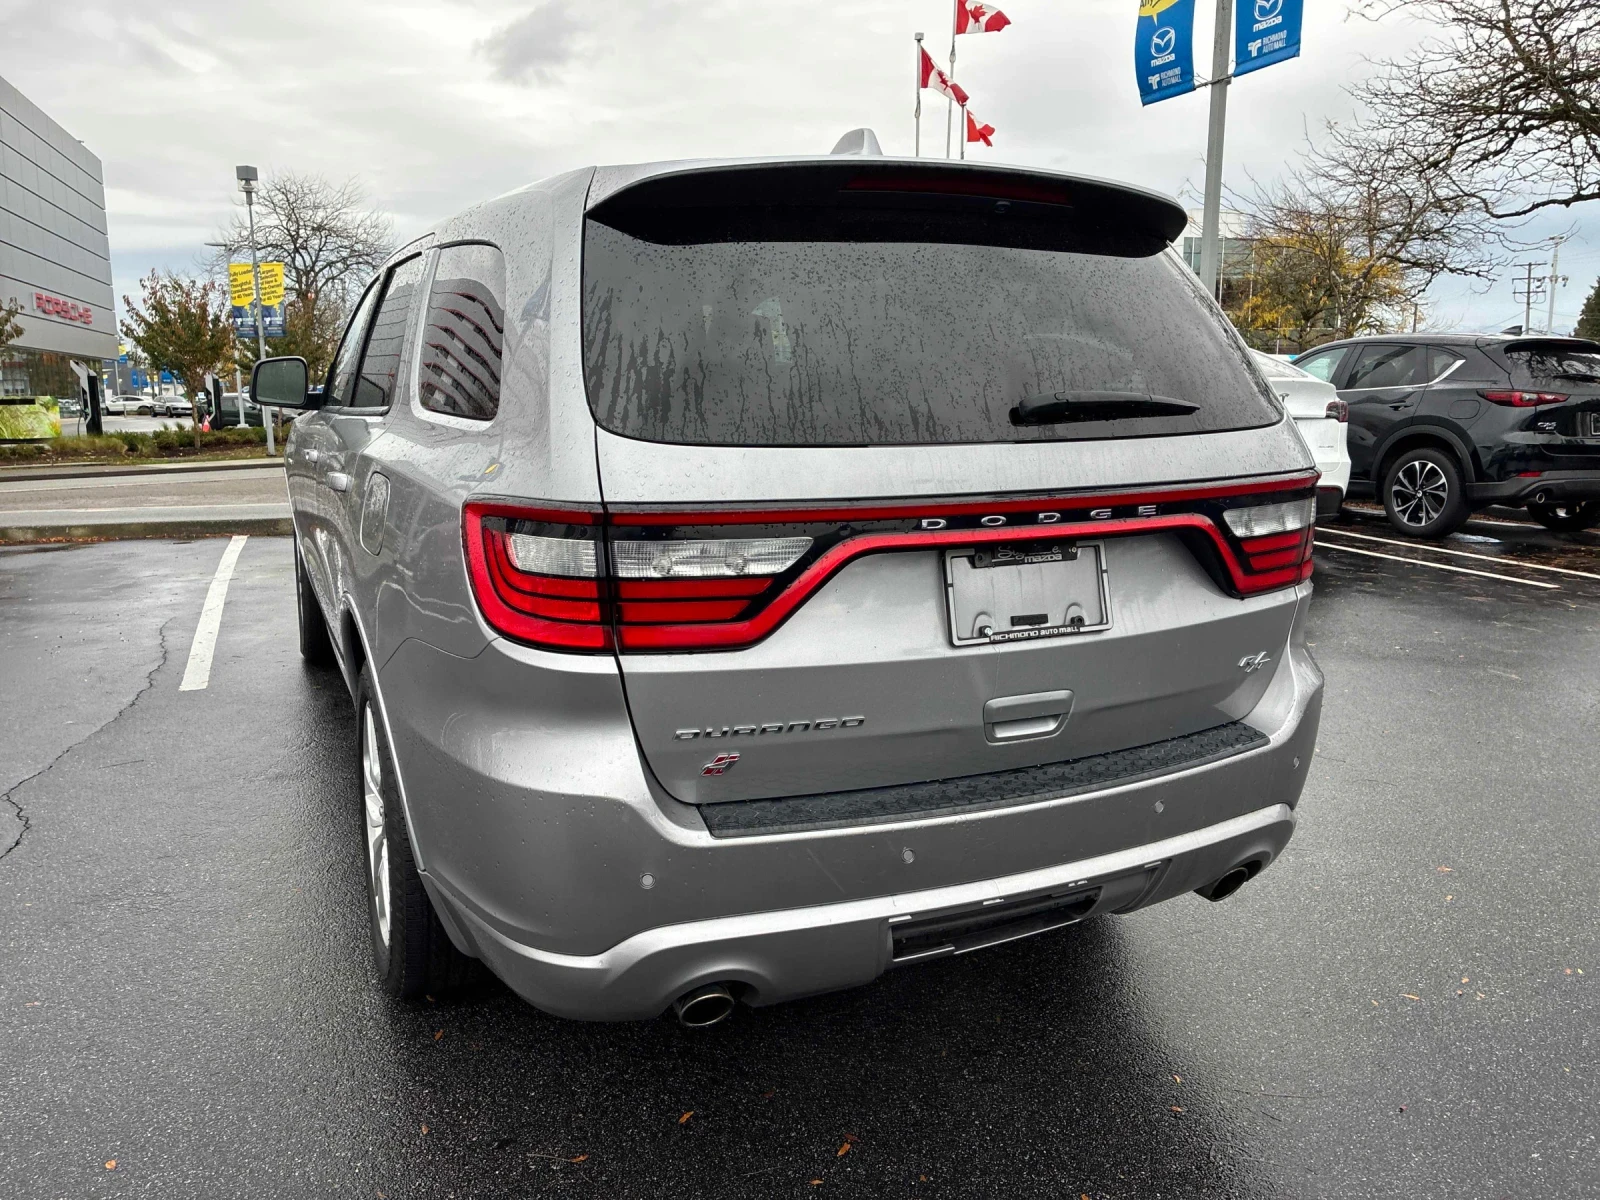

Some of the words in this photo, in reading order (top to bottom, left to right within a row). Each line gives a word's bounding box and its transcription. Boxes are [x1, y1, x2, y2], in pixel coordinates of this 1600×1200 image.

[1253, 15, 1283, 32] mazda
[1263, 30, 1288, 45] RICHMOND
[1151, 53, 1176, 67] mazda
[1160, 66, 1182, 79] RICHMOND
[31, 292, 93, 325] PORSCHE
[921, 504, 1158, 530] DODGE
[1024, 553, 1063, 563] mazda
[990, 630, 1039, 641] RICHMOND
[673, 714, 866, 741] DURANGO
